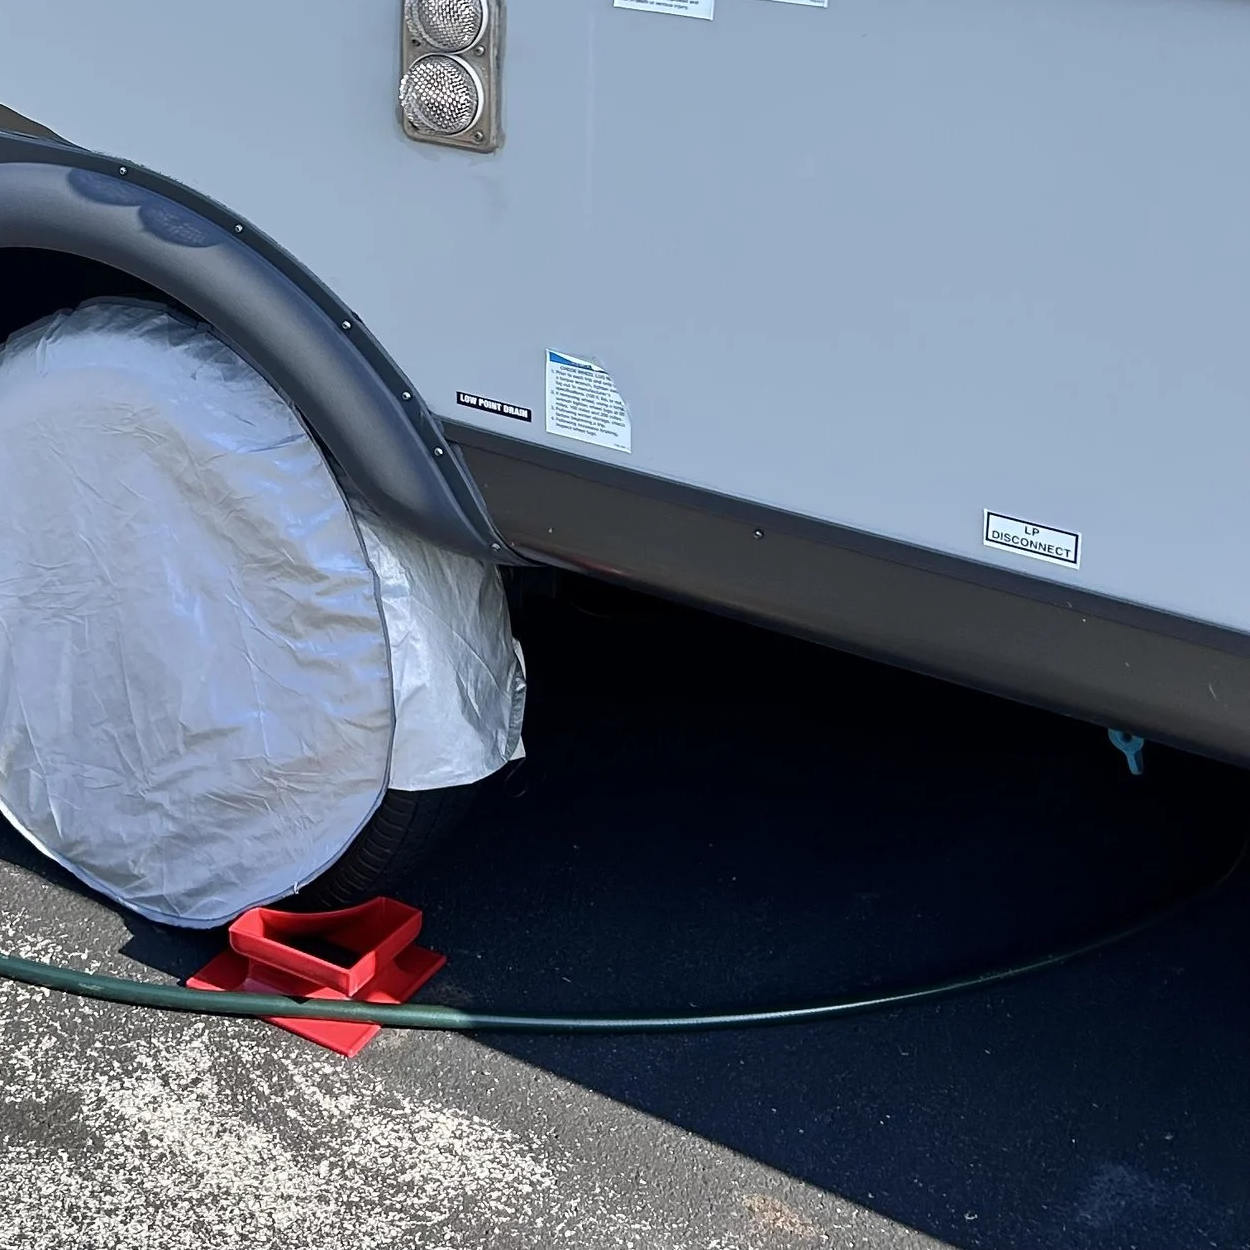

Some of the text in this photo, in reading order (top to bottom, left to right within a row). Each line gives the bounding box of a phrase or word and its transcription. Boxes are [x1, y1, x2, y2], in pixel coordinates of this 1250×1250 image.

[460, 394, 528, 418] LOW POINT DRAIN
[1024, 525, 1040, 536] LP
[992, 530, 1071, 557] DISCONNECT
